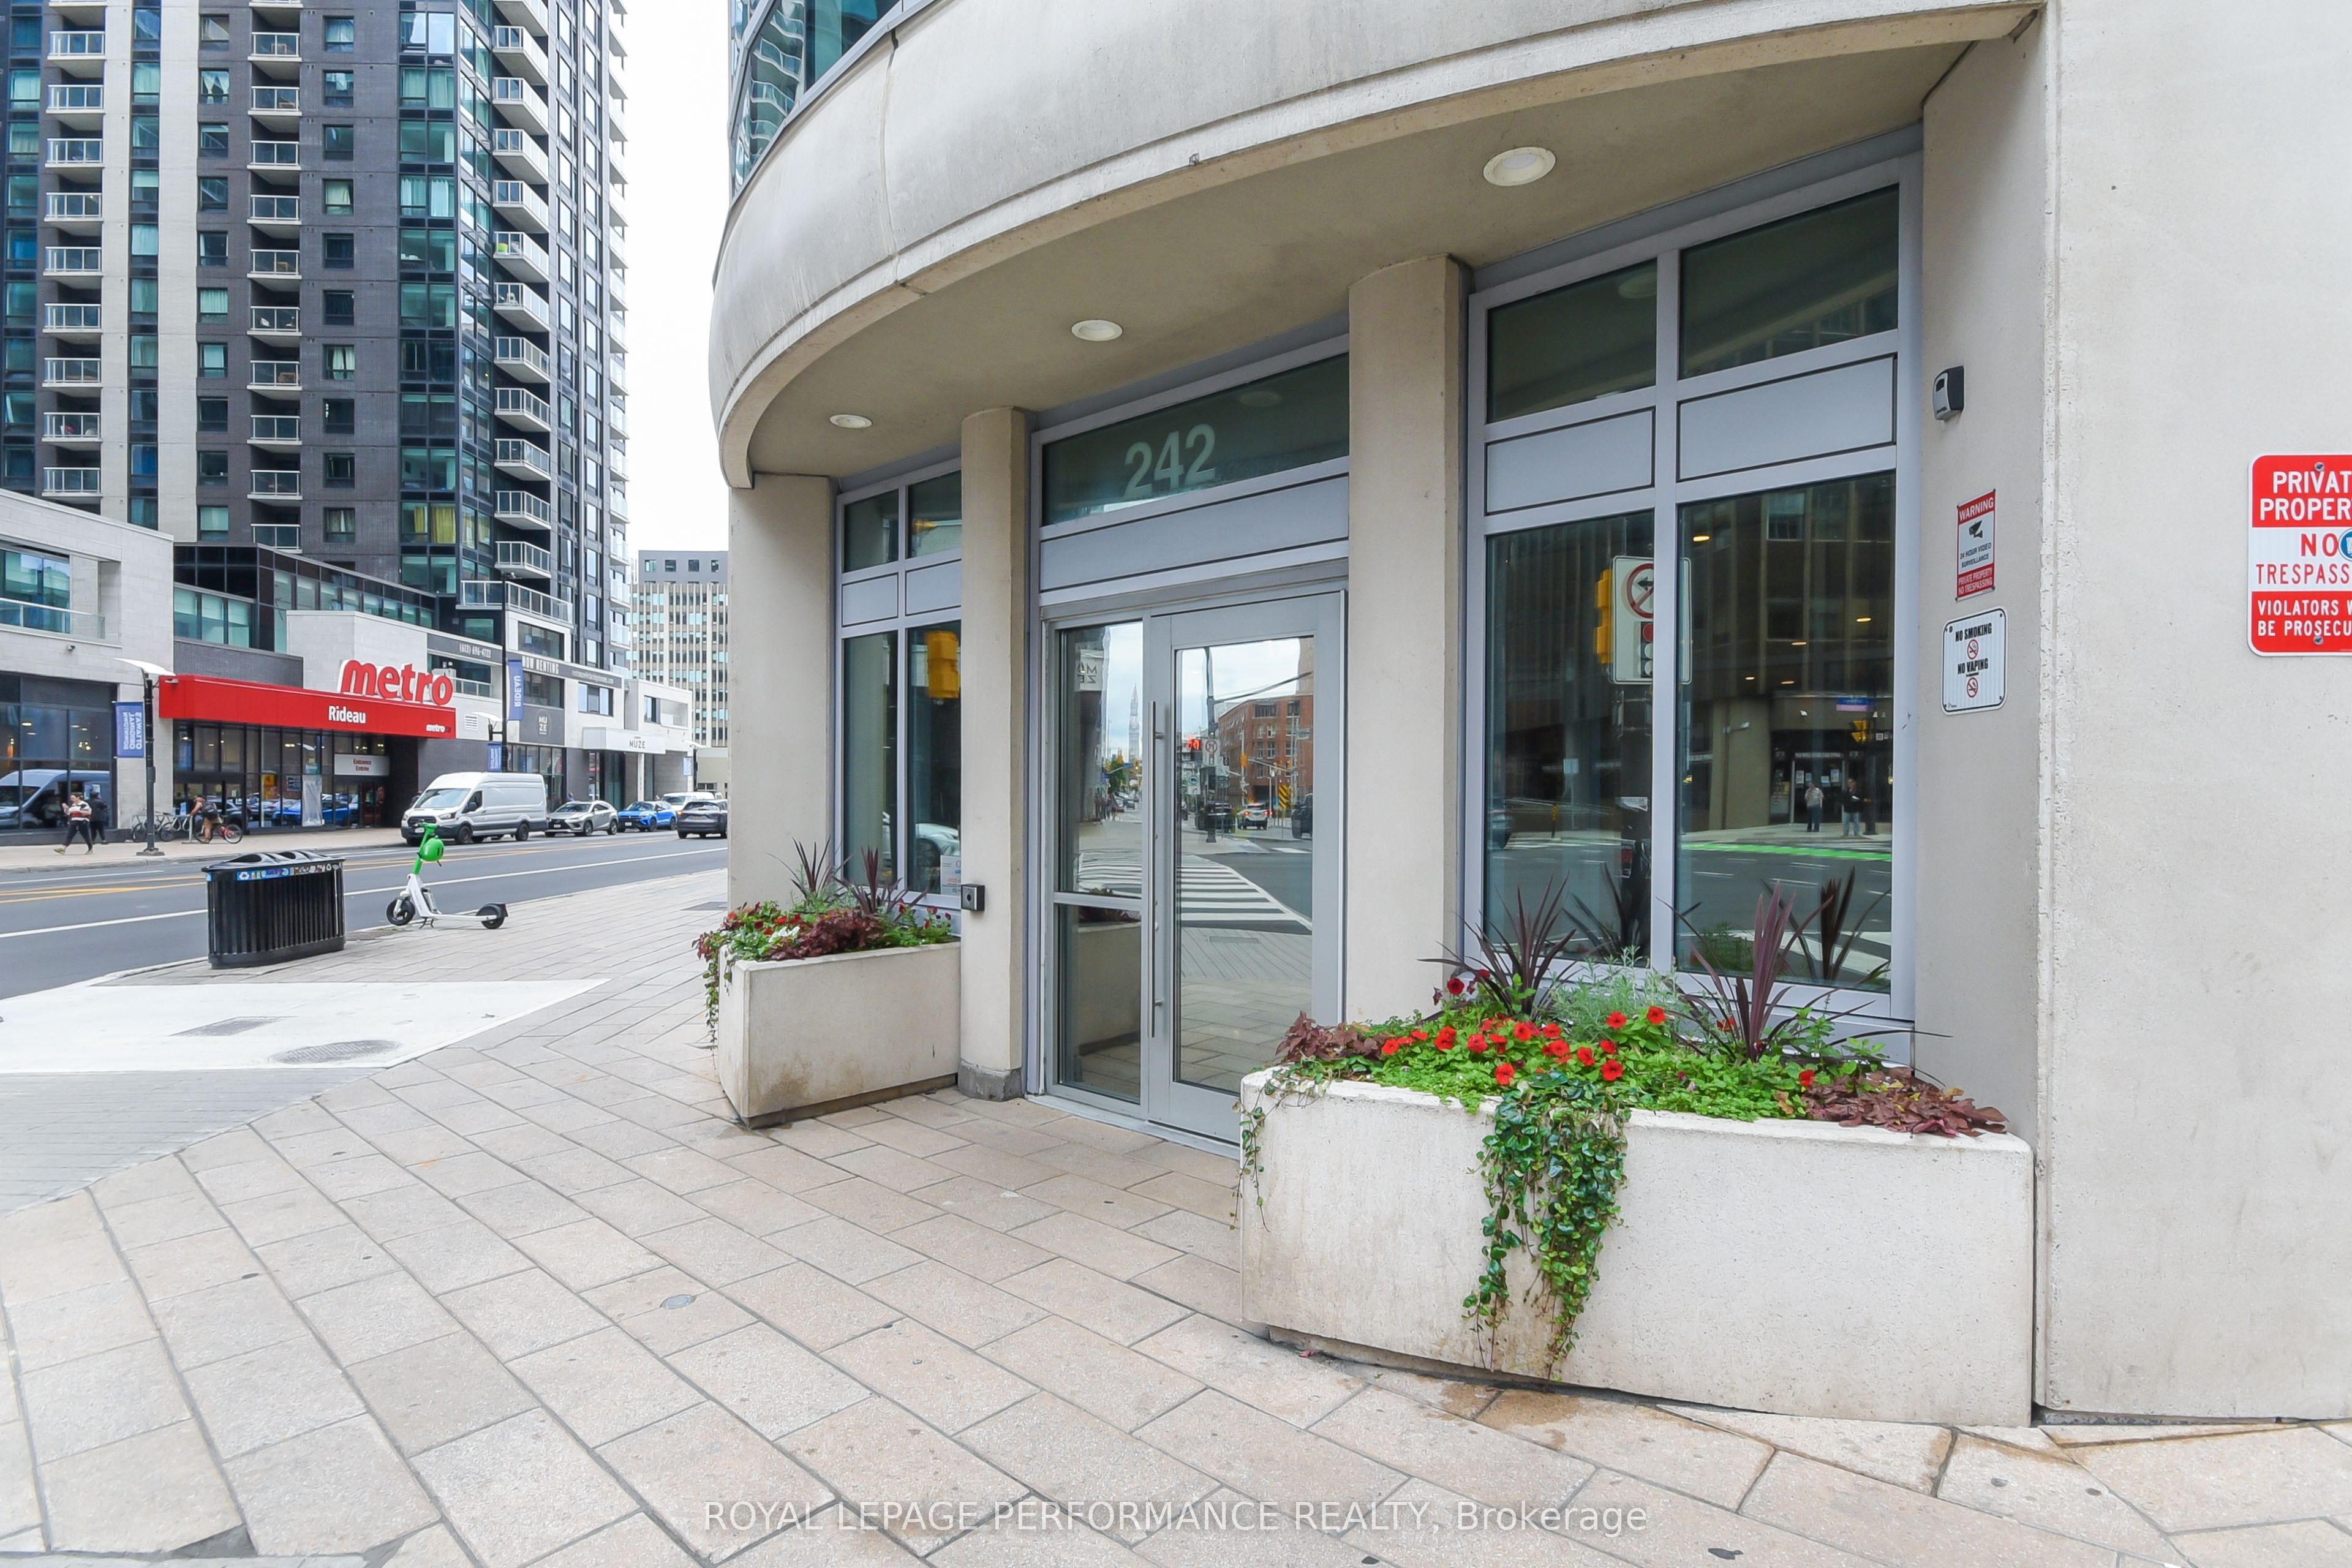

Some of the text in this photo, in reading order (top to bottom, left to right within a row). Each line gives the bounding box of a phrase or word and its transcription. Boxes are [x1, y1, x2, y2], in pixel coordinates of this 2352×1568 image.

[1124, 424, 1215, 500] 242
[1959, 497, 1994, 521] WARNING
[2260, 497, 2352, 521] PROPER
[1966, 548, 1977, 557] HOUR
[1978, 542, 1991, 552] VIDEO
[2301, 533, 2339, 557] NO
[1962, 553, 1989, 568] SURVEILLANCE
[1959, 567, 1992, 586] PRIVATE PROPERTY
[2256, 564, 2350, 584] TRESPASS
[1959, 576, 1992, 595] NO TRESPASSING
[2258, 600, 2339, 616] VIOLATORS
[1956, 623, 1992, 642] NO SMOKING
[2258, 620, 2275, 636] BE
[522, 655, 559, 674] NOW RENTING
[1958, 658, 1988, 674] NO VAPING
[340, 659, 453, 706] metro
[328, 706, 366, 723] Rideau
[629, 740, 646, 749] MUZE
